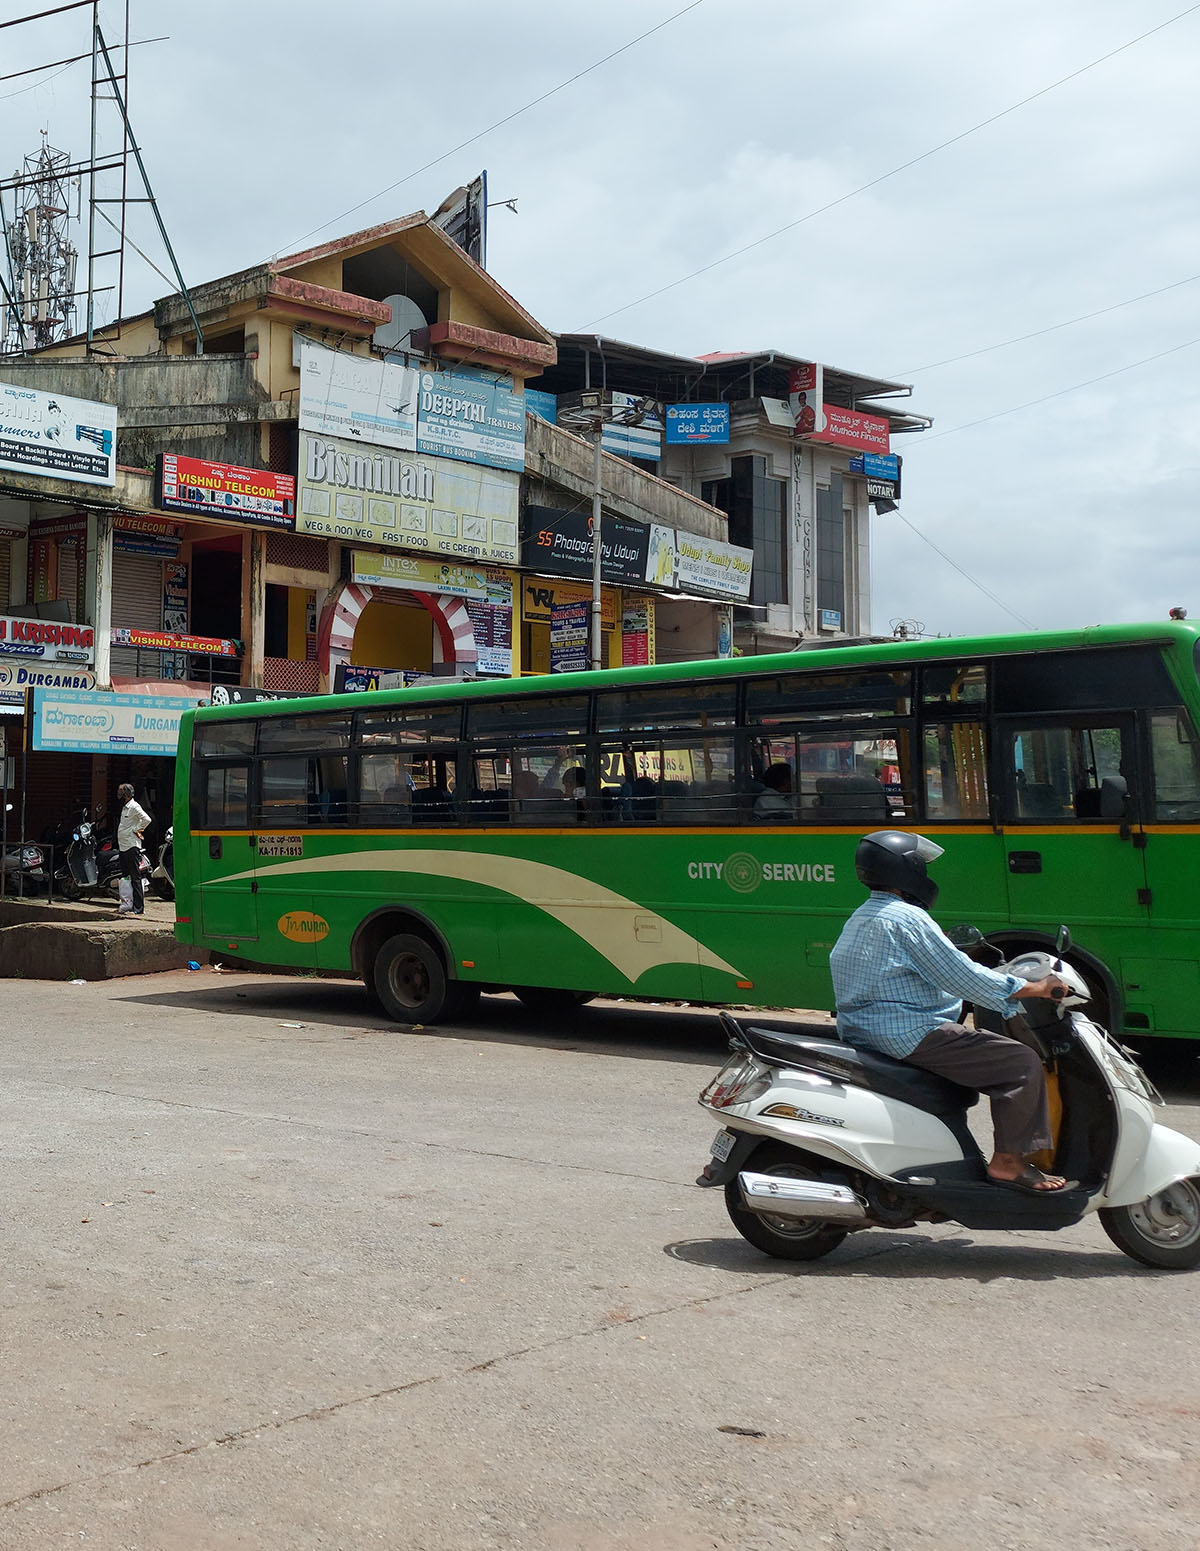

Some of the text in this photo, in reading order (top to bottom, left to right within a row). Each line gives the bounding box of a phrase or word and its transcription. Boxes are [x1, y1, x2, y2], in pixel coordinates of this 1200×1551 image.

[421, 391, 487, 425] DEEPTHI
[487, 416, 522, 432] TRAVELS
[830, 424, 887, 445] Muthoot Finance
[0, 441, 19, 450] Board
[25, 445, 47, 455] Backlit
[48, 449, 67, 459] Board
[91, 457, 106, 466] Print
[420, 440, 477, 459] TOURIST BUS BOOKING
[17, 453, 48, 464] Hoardings
[54, 459, 70, 468] Steel
[71, 461, 89, 471] Letter
[305, 436, 435, 503] Bismillah
[178, 472, 222, 489] VISHNU
[224, 480, 275, 498] TELECOM
[867, 484, 895, 498] NOTARY
[127, 519, 167, 534] TELECOM
[305, 520, 323, 531] VEG
[325, 524, 333, 533] &
[355, 528, 373, 539] VEG
[382, 532, 405, 543] FAST
[406, 536, 429, 547] FOOD
[438, 540, 451, 551] ICE
[452, 543, 481, 555] CREAM
[482, 548, 488, 556] &
[489, 549, 514, 560] JUICES
[536, 530, 640, 561] SS Photograhy Udupi
[681, 542, 751, 575] Udupi Family Shop
[11, 620, 94, 648] KRISHNA
[130, 636, 171, 647] VISHNU
[173, 640, 222, 652] TELECOM
[16, 668, 89, 689] DURGAMBA
[134, 713, 180, 731] DURGAM
[259, 846, 303, 856] KA-17 F-1813
[687, 862, 835, 882] CITY SERVICE
[794, 1108, 845, 1128] Access
